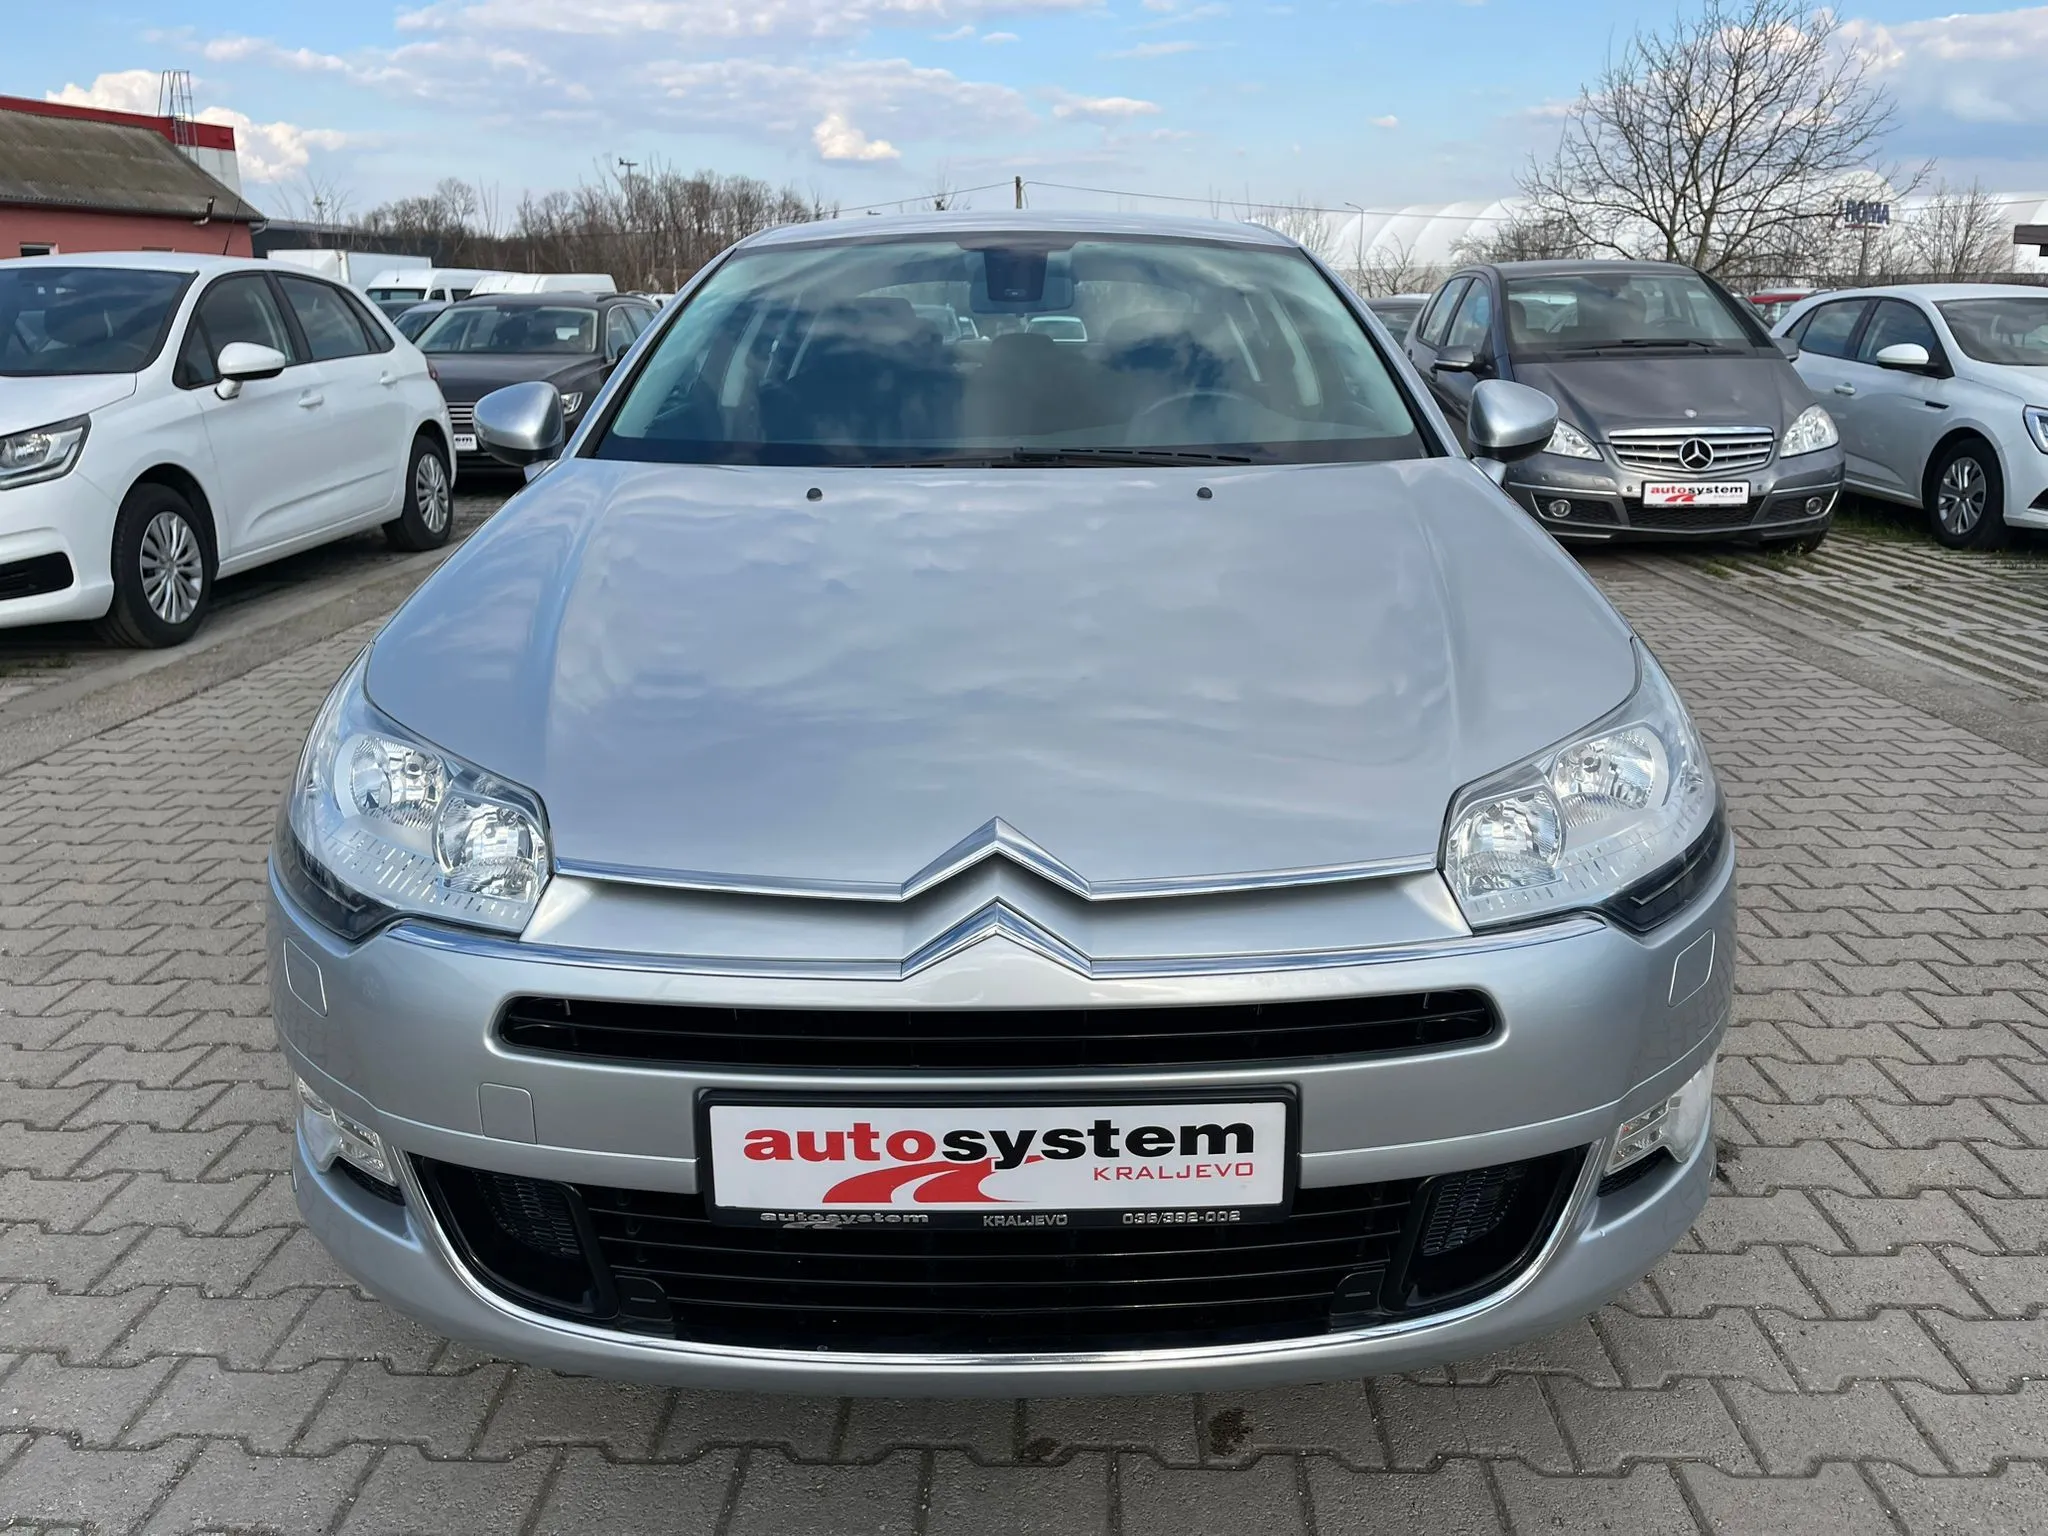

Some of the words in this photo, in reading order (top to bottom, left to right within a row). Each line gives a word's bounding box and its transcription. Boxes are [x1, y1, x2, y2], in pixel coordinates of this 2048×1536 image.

[1650, 485, 1743, 495] autosystem
[743, 1119, 1254, 1169] autosystem
[1093, 1162, 1254, 1181] KRALJEVO
[760, 1211, 929, 1225] autosystem
[983, 1213, 1069, 1227] KRALJEVO
